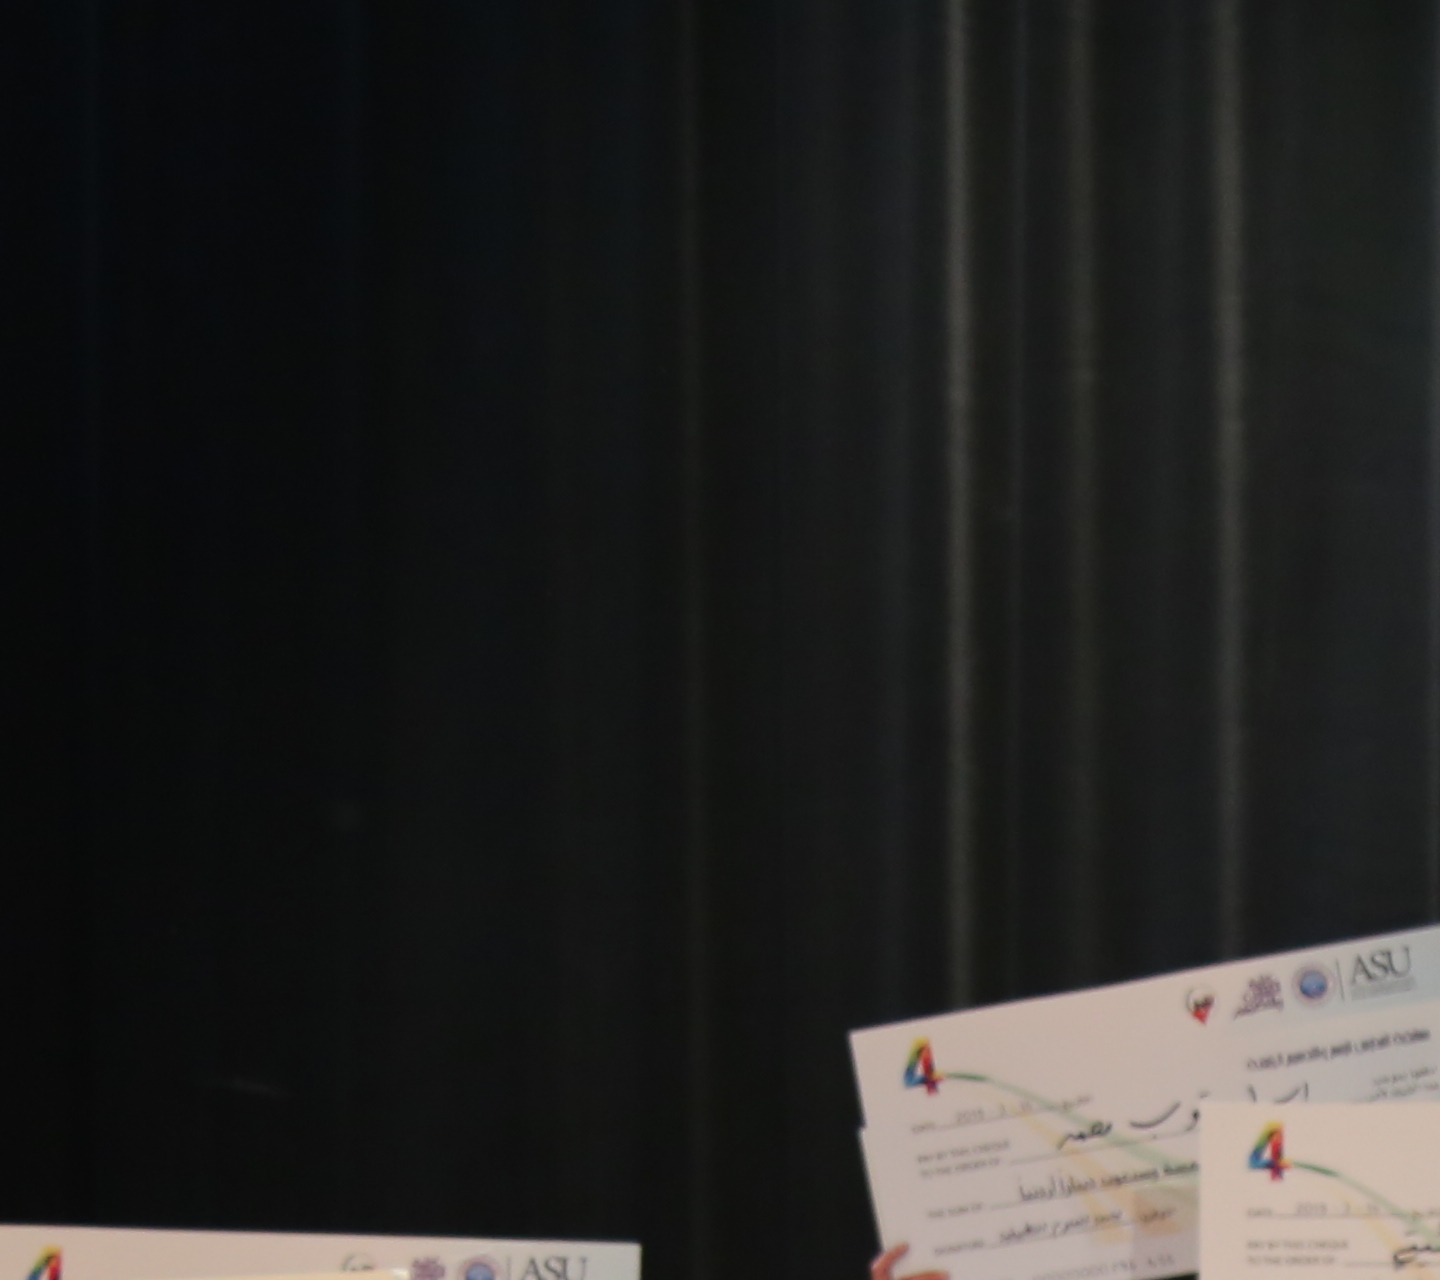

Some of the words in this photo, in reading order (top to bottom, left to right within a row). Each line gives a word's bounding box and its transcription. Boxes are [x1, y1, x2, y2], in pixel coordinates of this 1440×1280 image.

[1349, 945, 1413, 987] ASU
[902, 1037, 945, 1096] 4
[1247, 1120, 1290, 1182] 4
